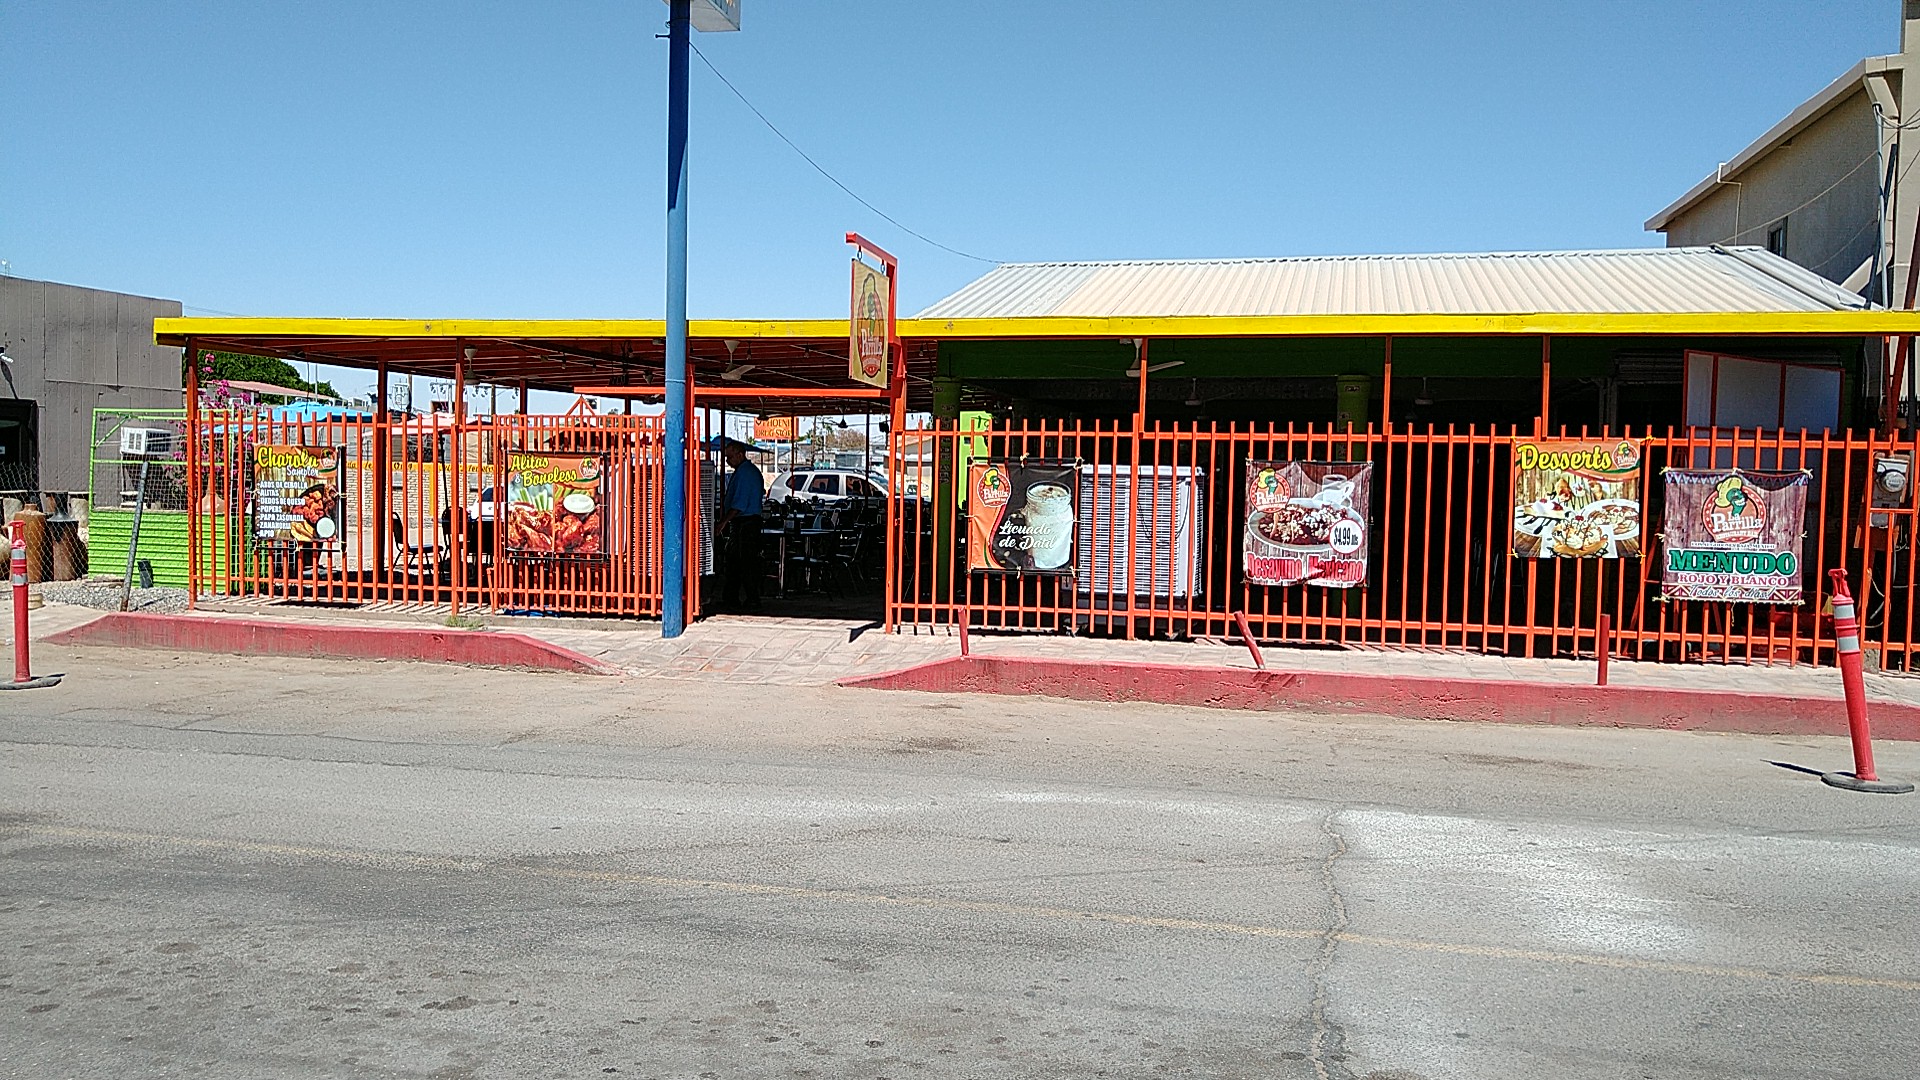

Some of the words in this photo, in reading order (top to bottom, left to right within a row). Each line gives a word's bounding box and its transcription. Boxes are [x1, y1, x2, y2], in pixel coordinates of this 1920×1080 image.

[861, 328, 882, 357] Parrilla
[762, 418, 790, 427] PHOENI
[257, 446, 319, 468] Charola
[511, 455, 549, 471] Alitas
[1517, 443, 1613, 470] Desserts
[286, 465, 319, 477] Sampler
[522, 466, 577, 487] Boneless
[260, 489, 279, 497] ALITAS
[1255, 491, 1289, 505] Parrilla
[260, 497, 279, 505] DEDOS
[280, 497, 286, 505] DE
[286, 498, 305, 506] QUESO
[260, 513, 275, 521] PAPA
[1711, 513, 1763, 532] Parrilla
[1728, 512, 1740, 520] La
[999, 520, 1051, 535] Licuado
[999, 535, 1017, 548] de
[1333, 526, 1351, 546] $4.99
[1247, 552, 1303, 581] Desayuno
[1308, 554, 1363, 581] Mexicano
[1668, 549, 1796, 576] MENUDO
[1680, 573, 1716, 584] ROJO
[1718, 575, 1728, 583] Y
[1731, 576, 1789, 587] BLANCO
[1690, 584, 1720, 597] Todos
[1724, 585, 1740, 598] los
